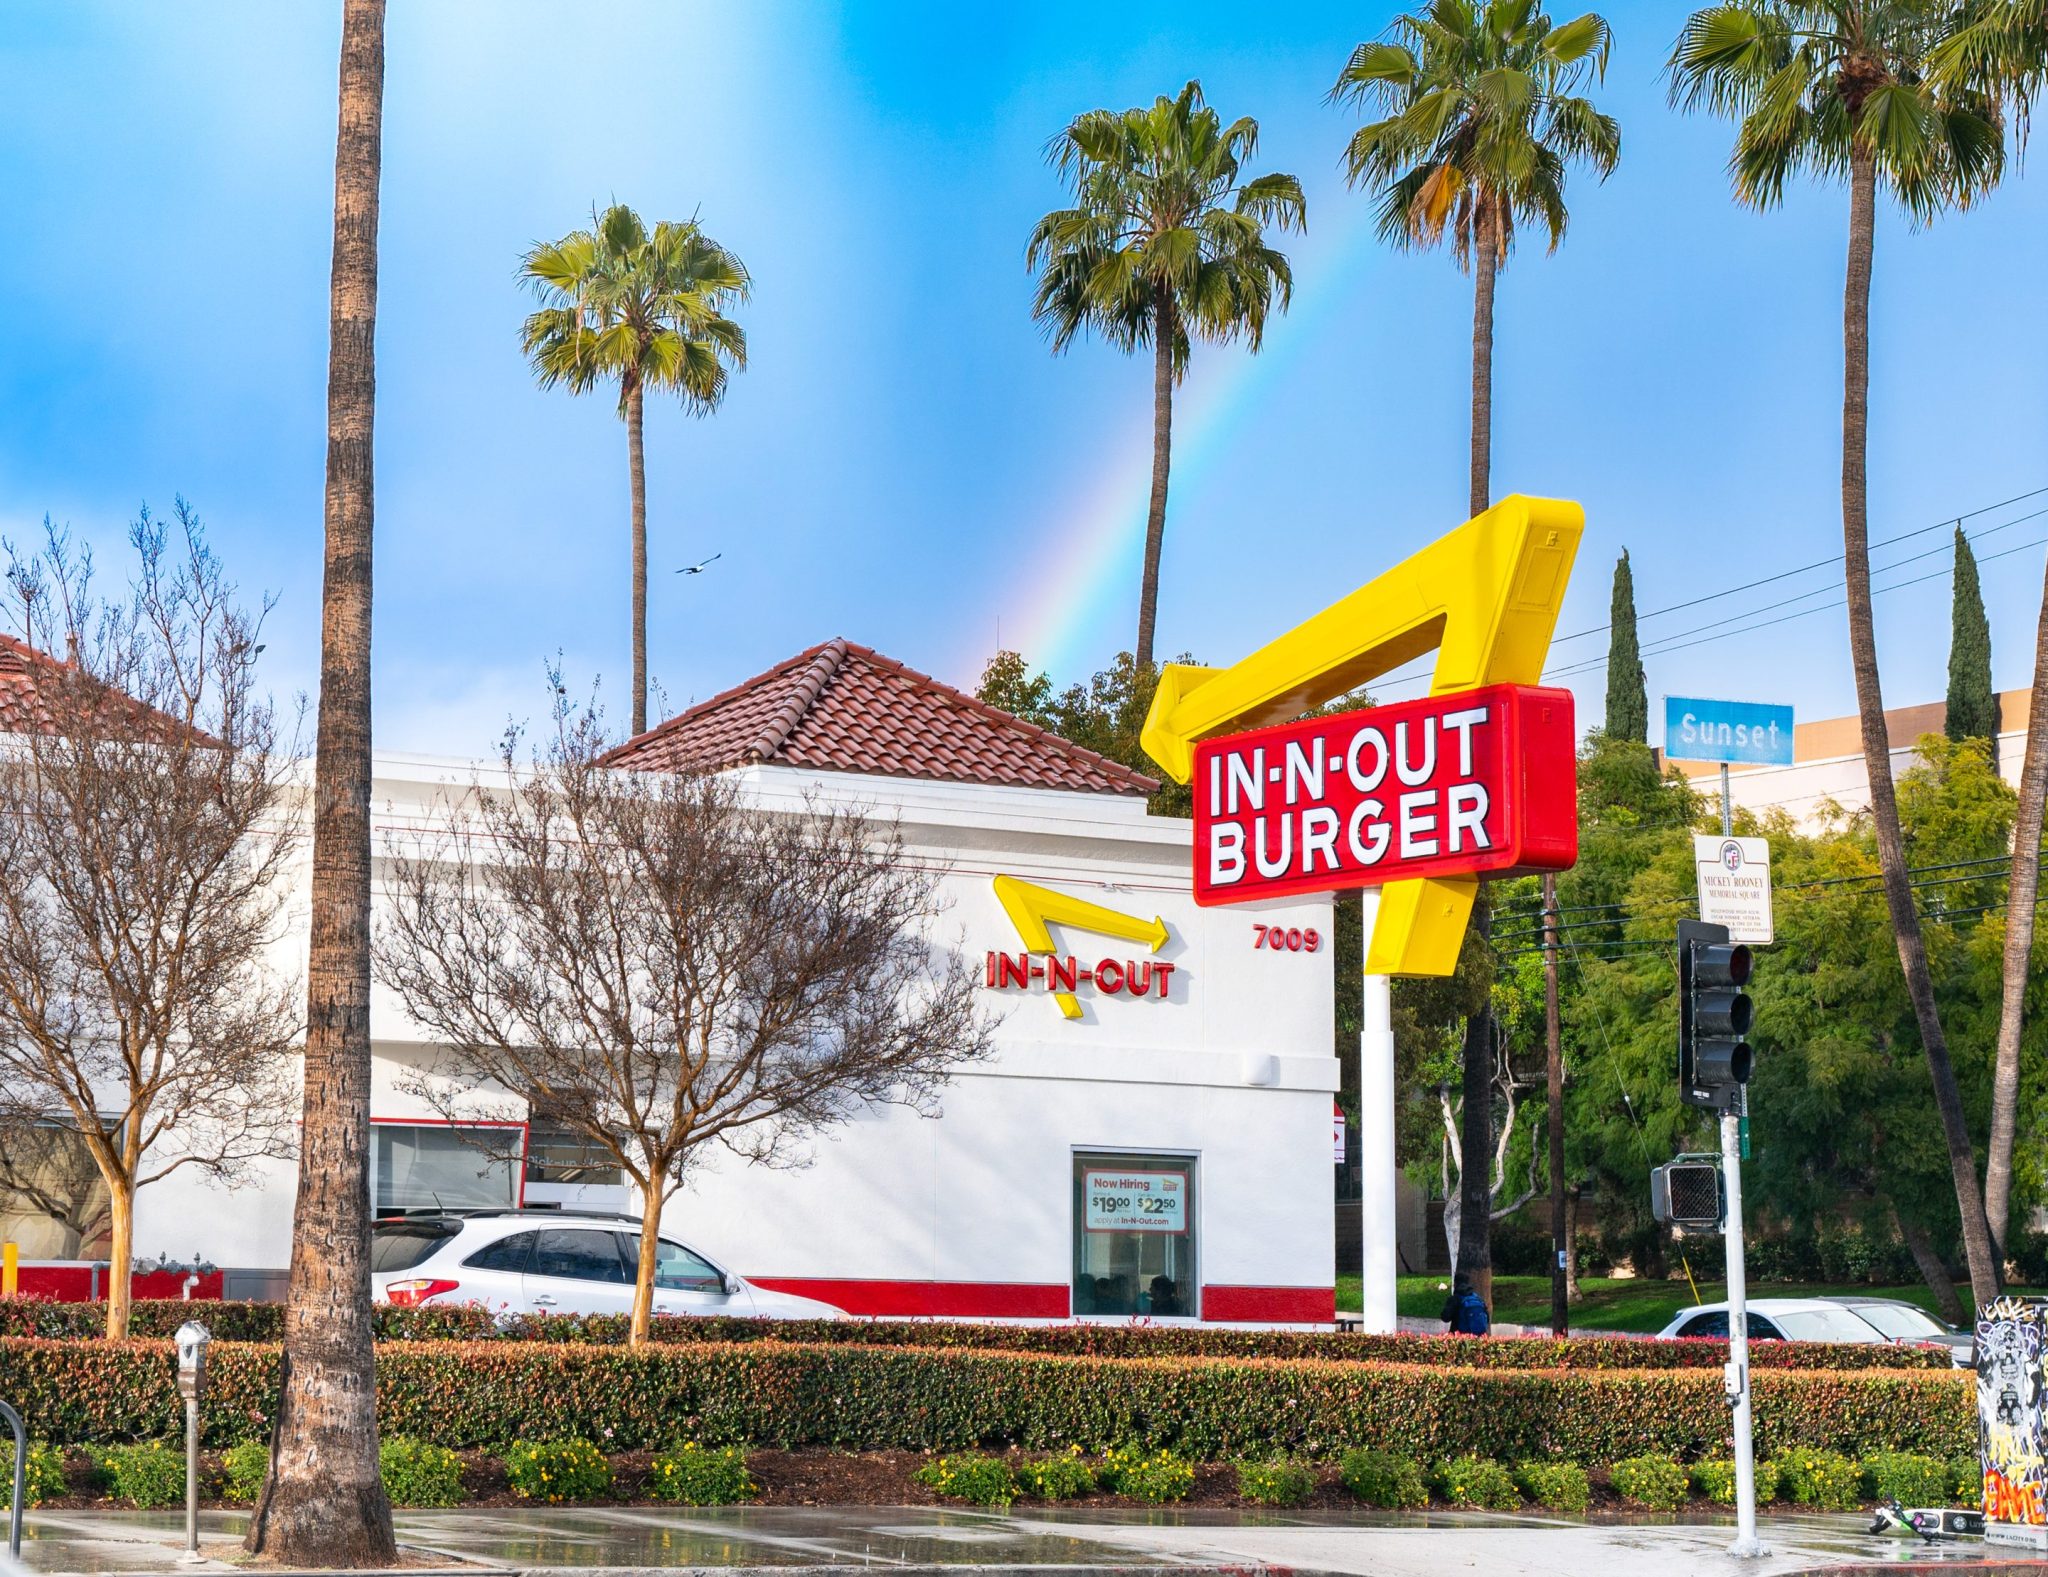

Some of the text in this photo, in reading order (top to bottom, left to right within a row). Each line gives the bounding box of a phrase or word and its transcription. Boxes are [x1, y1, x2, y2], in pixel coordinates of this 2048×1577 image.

[1680, 712, 1779, 750] Sunset
[1209, 782, 1491, 886] BURGER
[1704, 876, 1763, 888] MICKEY ROONEY
[1709, 889, 1760, 901] MEMORIAL SQUARE
[1252, 923, 1319, 953] 7009
[985, 951, 1175, 999] IN-N-OUT
[1094, 1178, 1117, 1188] Now
[1119, 1178, 1150, 1191] Hiring
[1094, 1217, 1113, 1225] apply
[1121, 1217, 1169, 1225] In-N-Out.com
